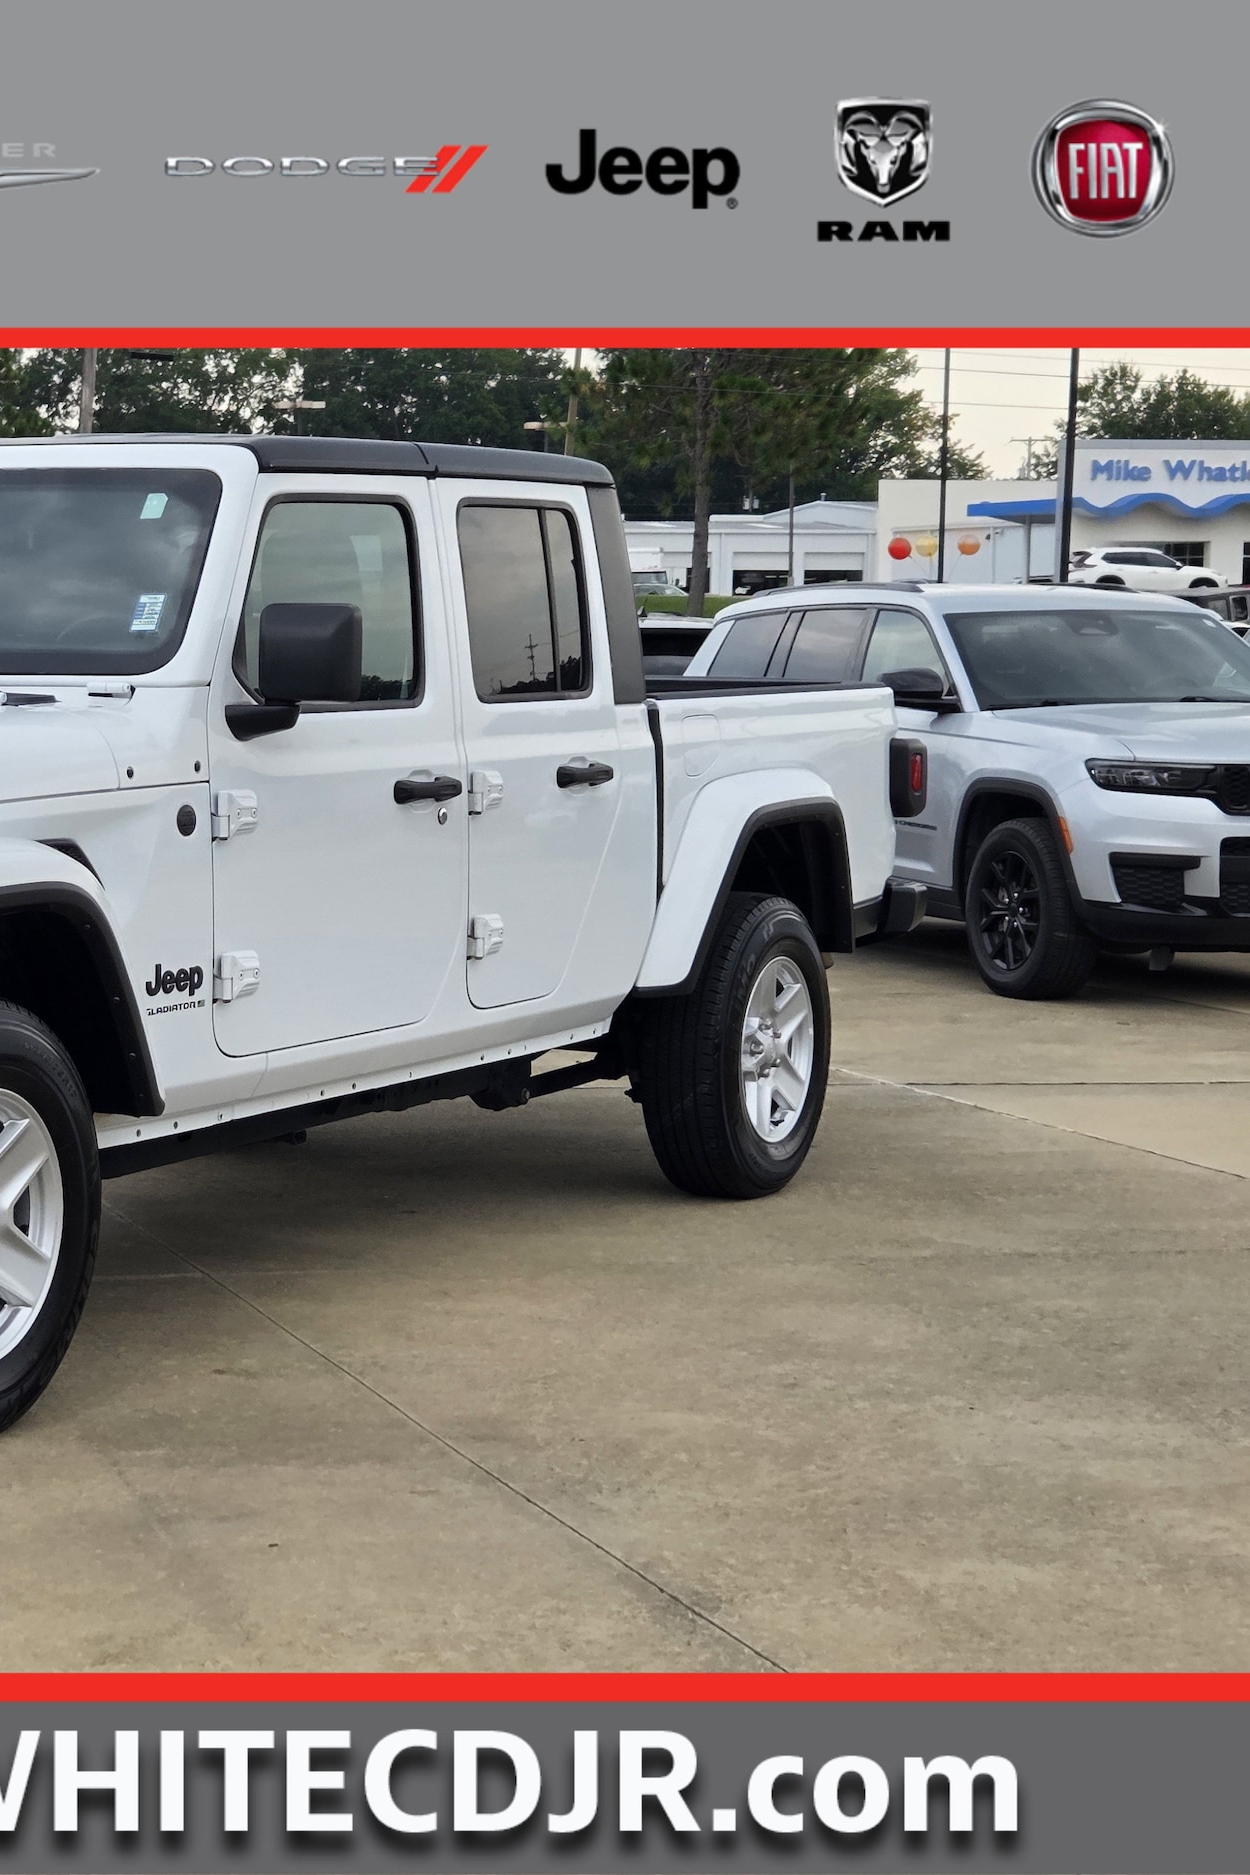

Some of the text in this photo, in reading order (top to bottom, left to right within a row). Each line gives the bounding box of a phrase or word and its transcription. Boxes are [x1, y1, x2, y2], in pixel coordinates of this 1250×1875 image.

[1090, 459, 1250, 482] Mike Whatl
[145, 963, 204, 997] Jeep
